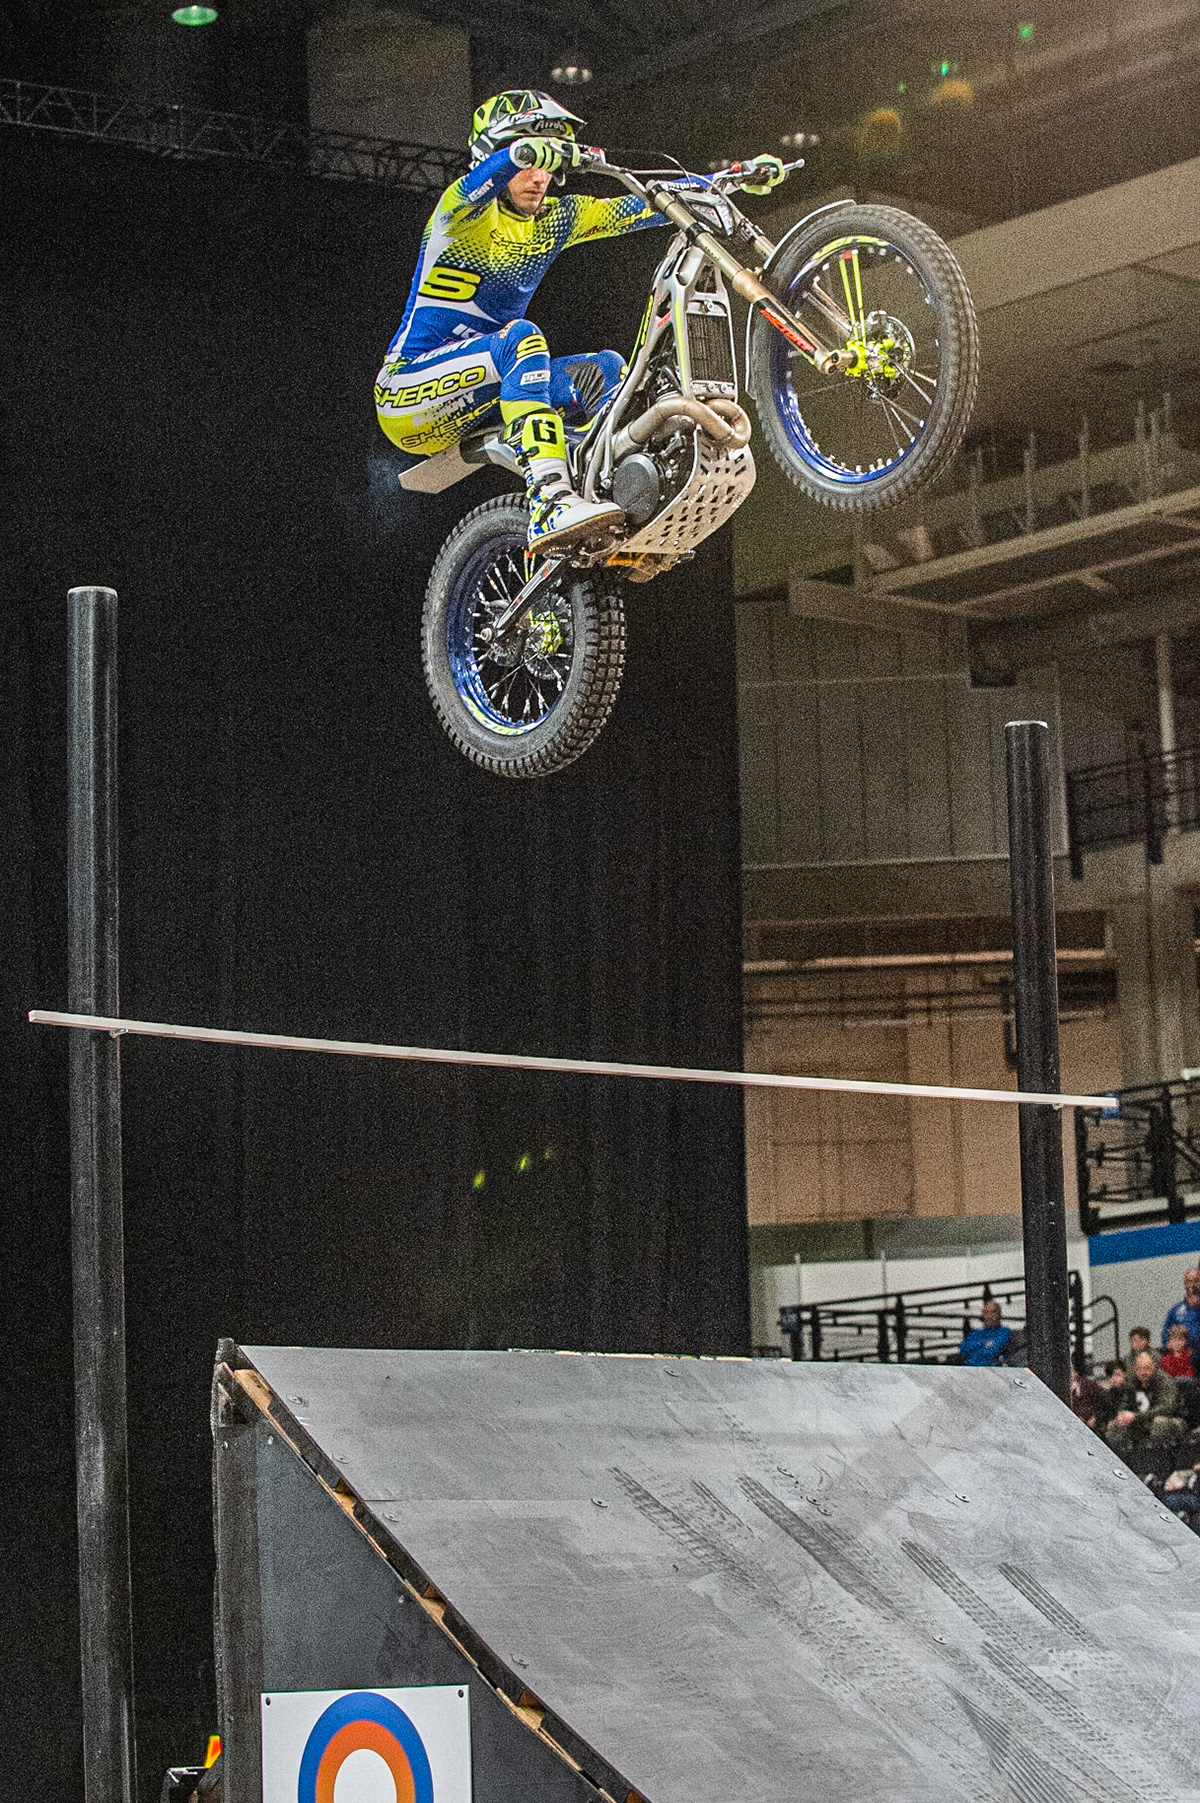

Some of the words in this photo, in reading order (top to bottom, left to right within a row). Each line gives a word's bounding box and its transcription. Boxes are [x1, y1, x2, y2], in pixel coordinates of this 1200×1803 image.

[418, 264, 482, 303] S
[515, 333, 549, 361] S
[373, 365, 487, 408] SHERCO
